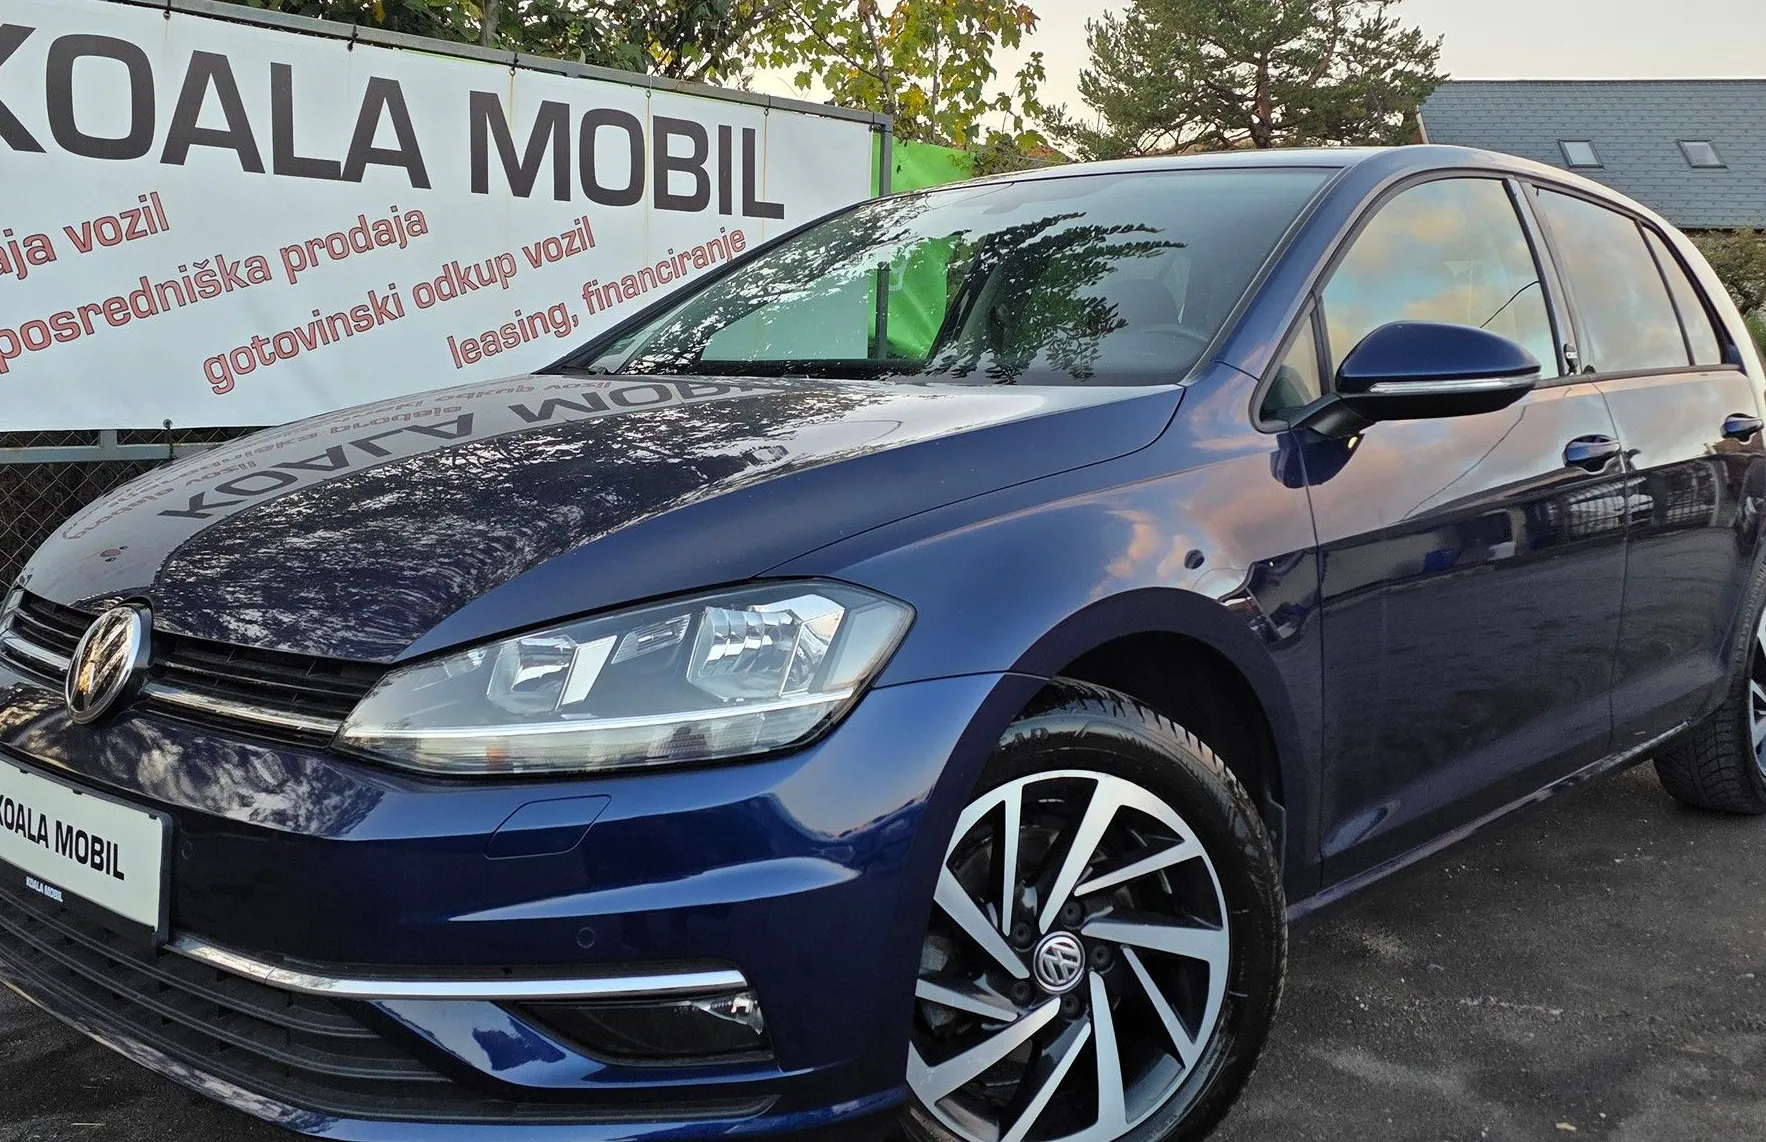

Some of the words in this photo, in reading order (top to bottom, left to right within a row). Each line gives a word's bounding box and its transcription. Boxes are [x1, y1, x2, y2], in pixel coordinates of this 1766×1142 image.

[469, 90, 784, 219] MOBIL
[0, 254, 272, 374] posredniška
[279, 206, 428, 284] prodaja
[63, 192, 169, 253] vozil
[203, 283, 405, 395] gotovinski
[412, 251, 516, 309] odkup
[522, 216, 595, 269] vozil
[447, 302, 579, 369] leasing,
[582, 227, 747, 316] financiranje
[55, 820, 125, 881] MOBIL
